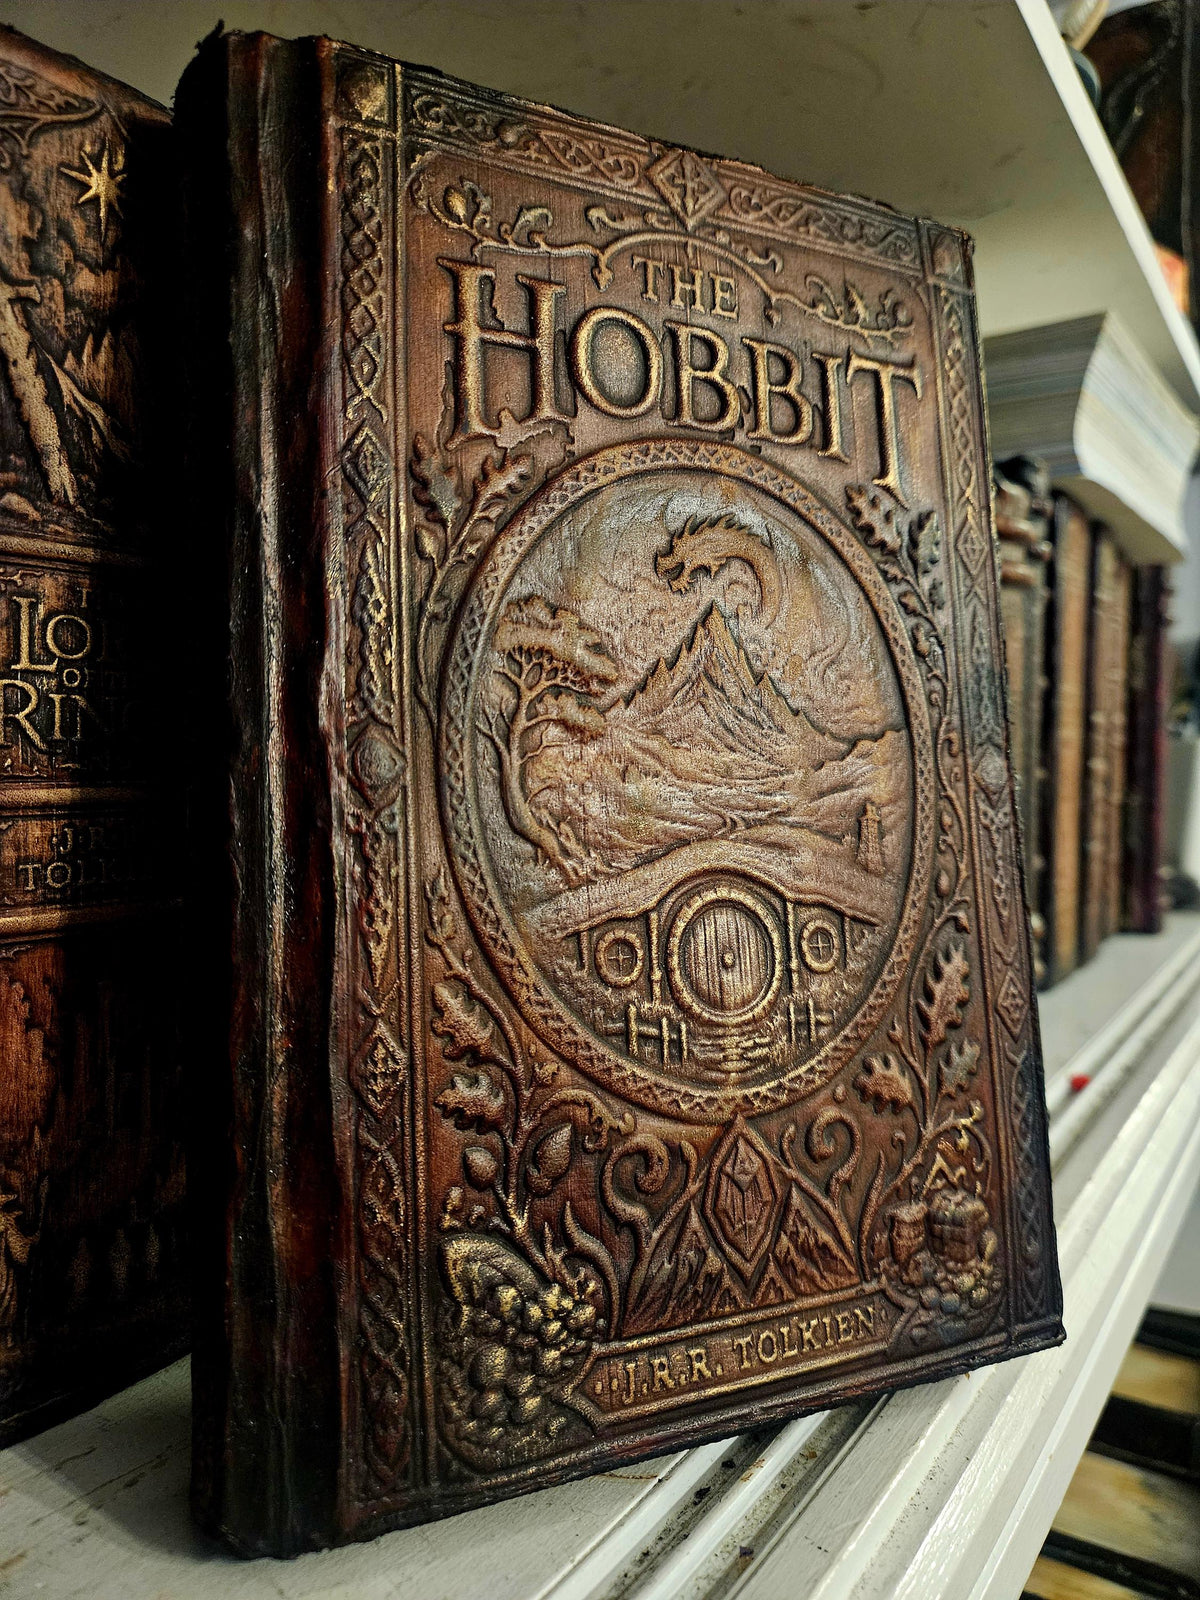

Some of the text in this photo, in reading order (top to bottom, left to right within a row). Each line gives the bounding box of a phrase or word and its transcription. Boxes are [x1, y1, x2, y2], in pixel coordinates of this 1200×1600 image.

[632, 255, 739, 321] THE
[437, 257, 922, 494] HOBBIT
[621, 1304, 877, 1405] J.R.R. TOLKIEN
